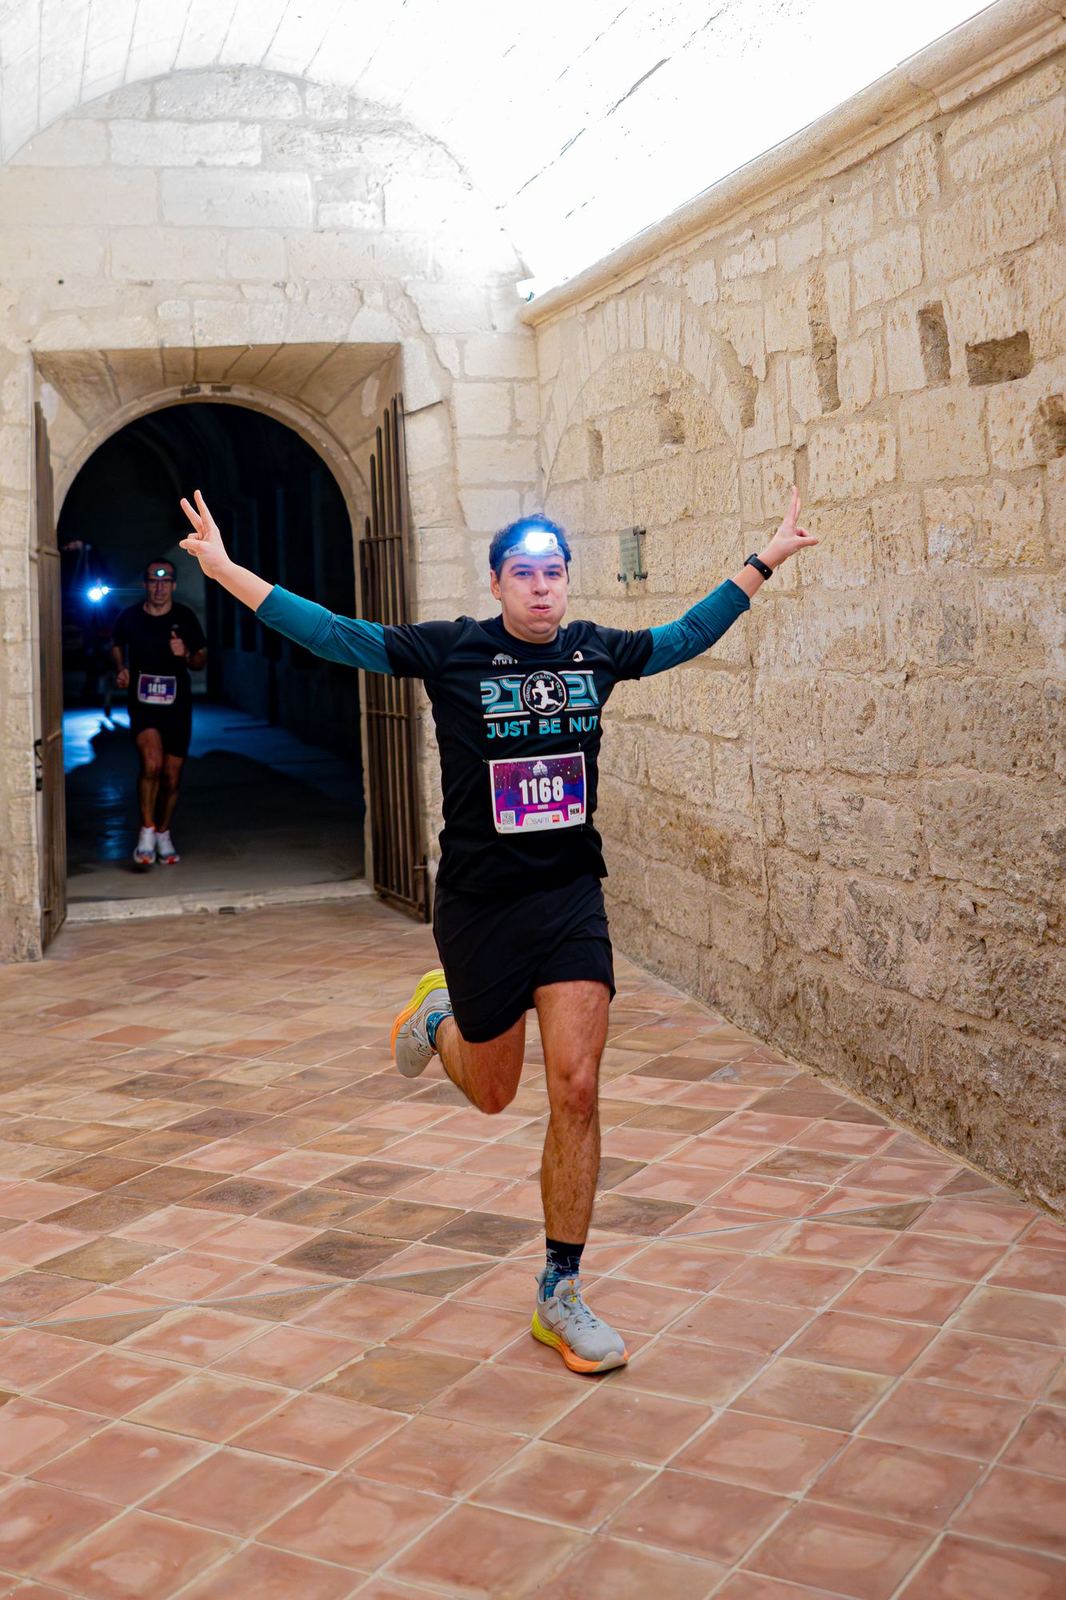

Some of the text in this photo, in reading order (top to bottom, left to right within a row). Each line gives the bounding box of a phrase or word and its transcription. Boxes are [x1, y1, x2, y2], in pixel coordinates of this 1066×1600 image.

[532, 674, 552, 682] URBAN
[486, 715, 599, 739] JUST BE NUT
[519, 776, 564, 805] 1168
